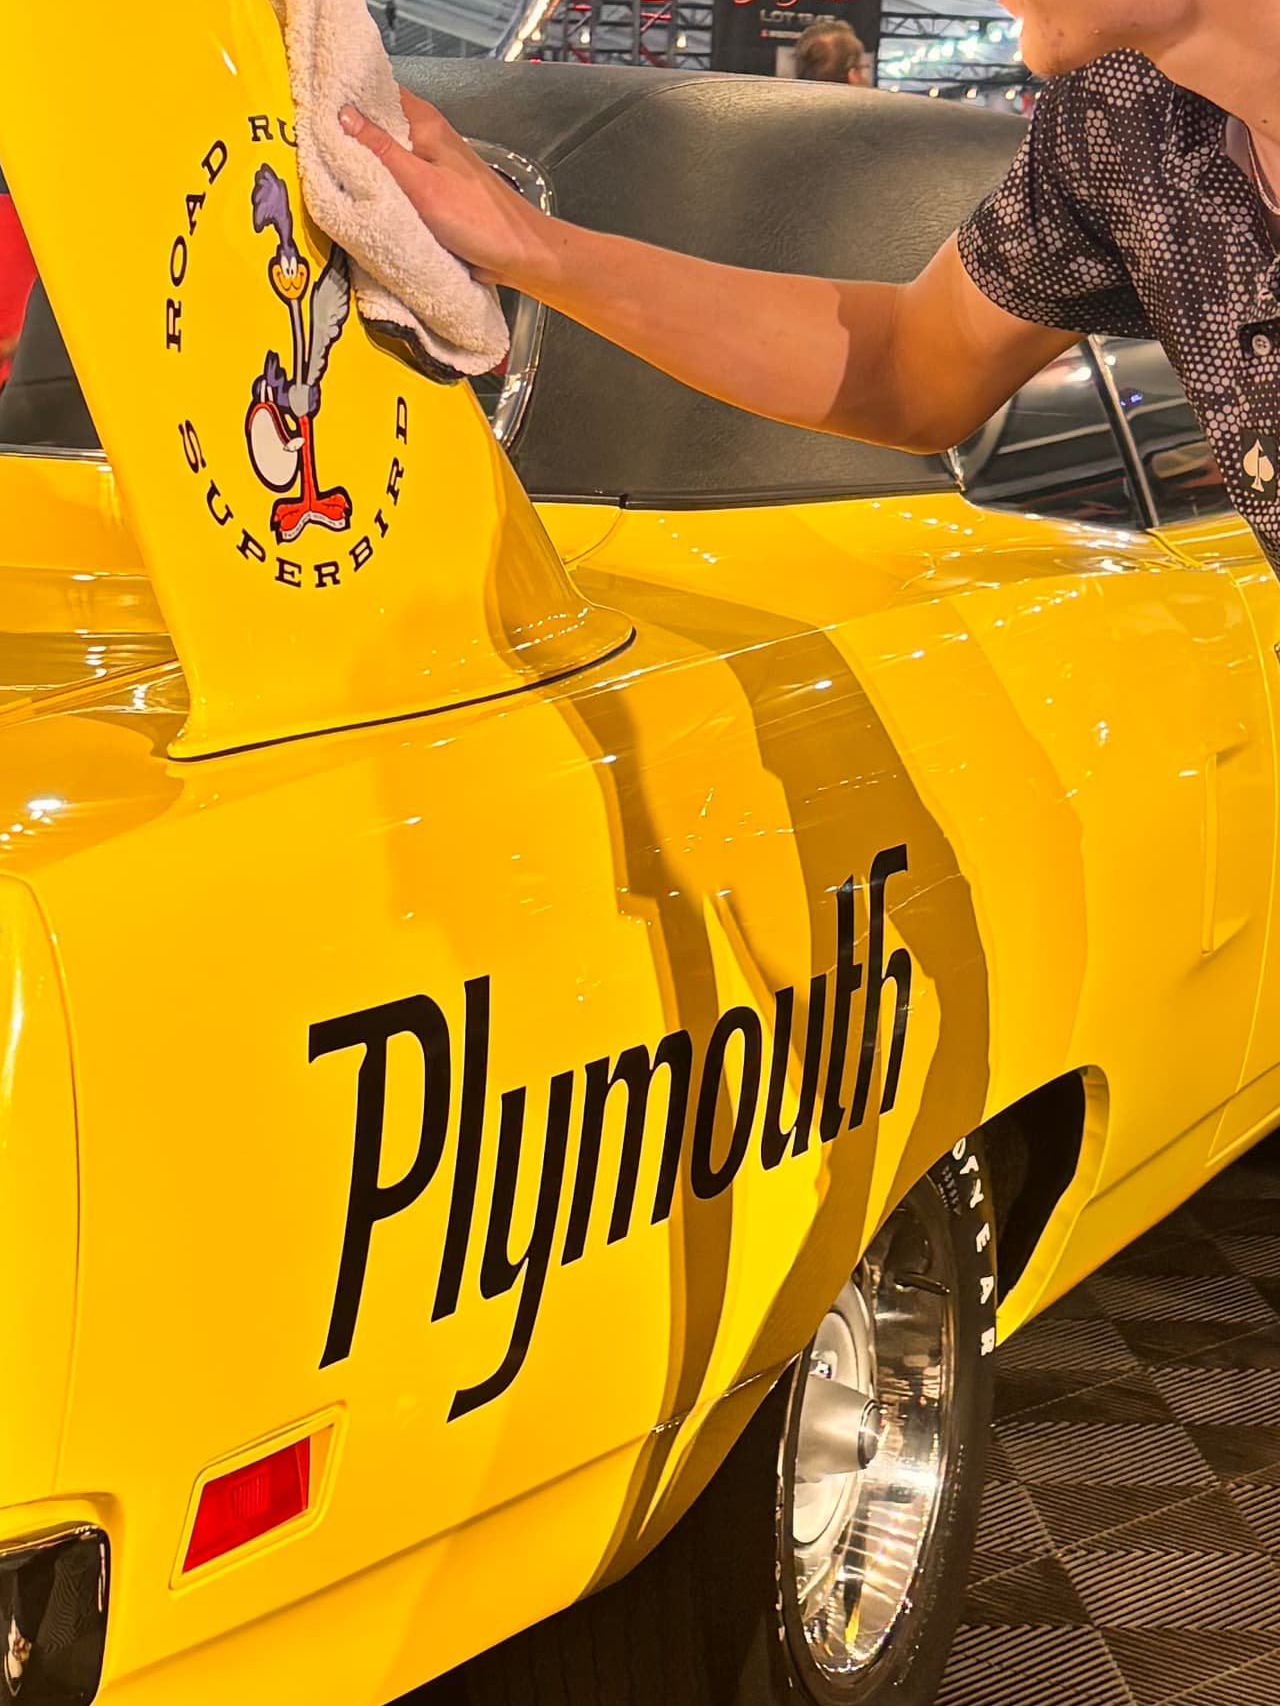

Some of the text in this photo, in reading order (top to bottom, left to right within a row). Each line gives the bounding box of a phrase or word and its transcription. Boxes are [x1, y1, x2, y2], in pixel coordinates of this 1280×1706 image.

[165, 139, 229, 353] ROAD
[178, 395, 409, 589] SUPERBIRD
[308, 844, 913, 1423] Plymouth
